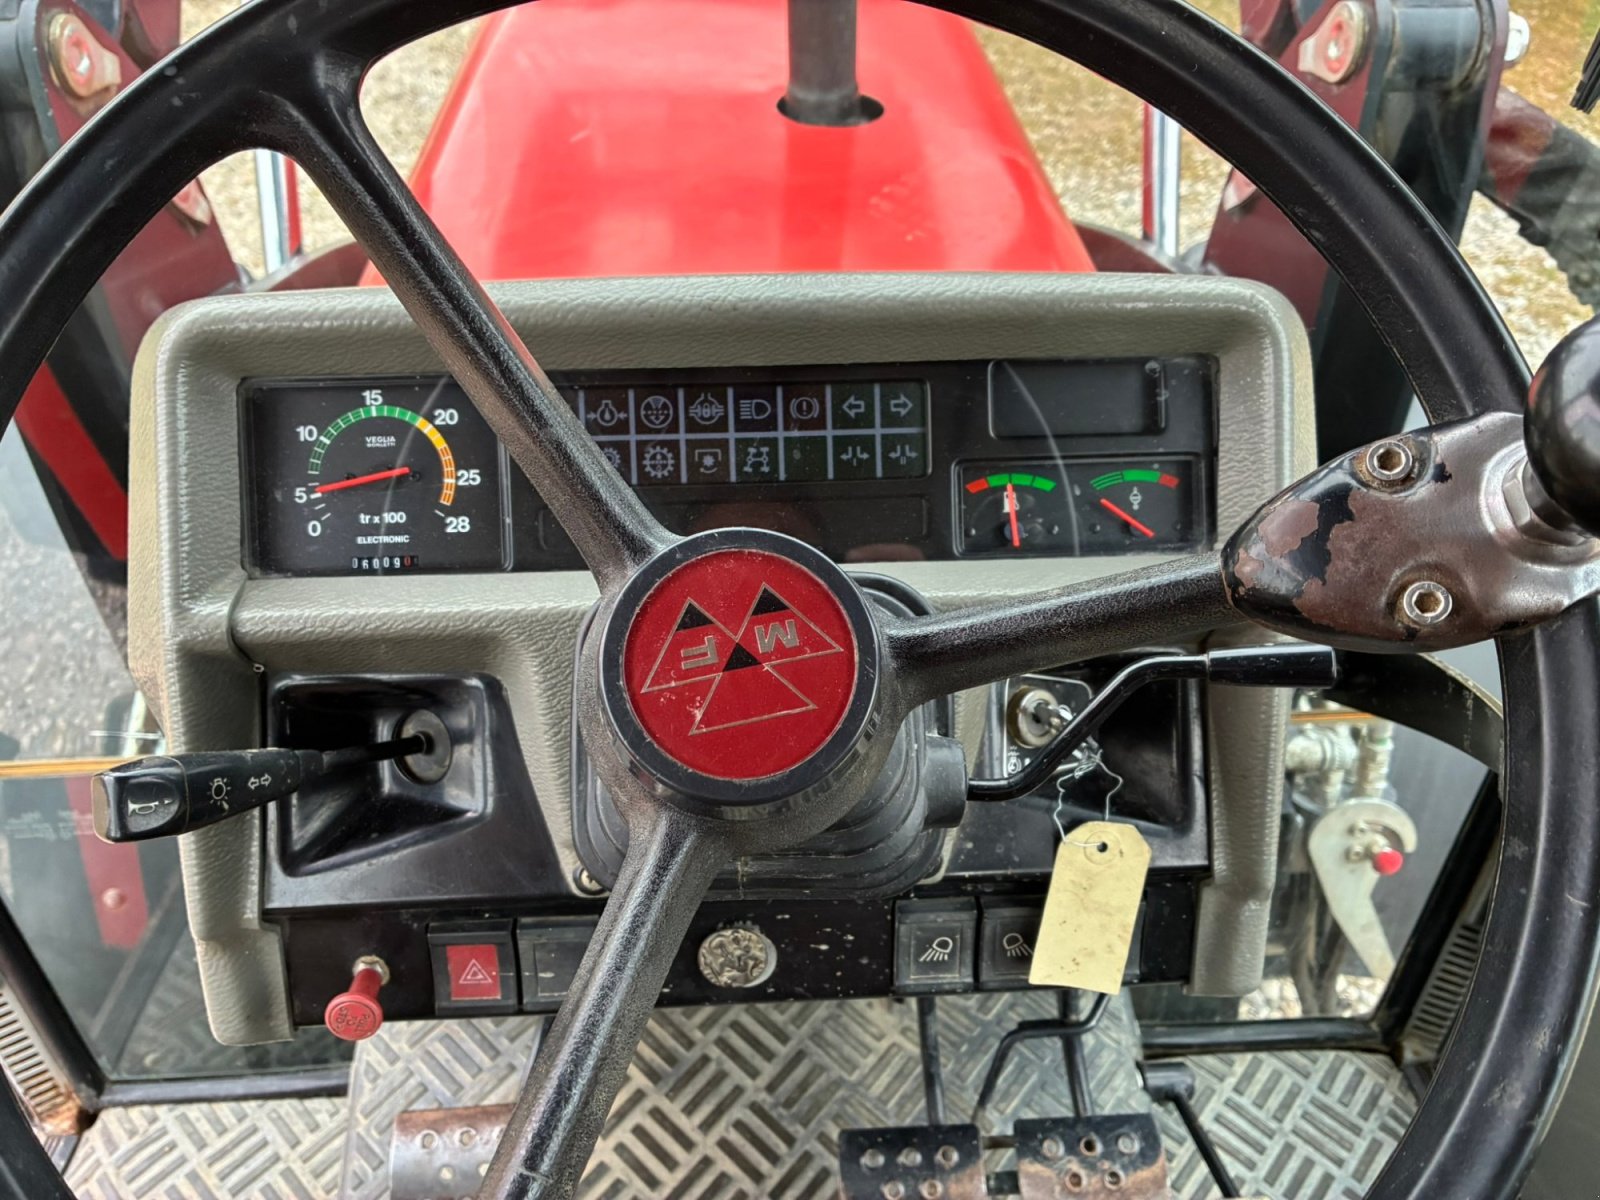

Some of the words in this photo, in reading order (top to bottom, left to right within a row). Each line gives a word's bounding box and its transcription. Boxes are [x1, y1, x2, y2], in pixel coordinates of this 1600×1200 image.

[362, 390, 383, 406] 15
[434, 409, 459, 425] 20
[296, 425, 318, 442] 10
[365, 435, 396, 443] VEGLIA
[457, 470, 481, 486] 25
[294, 488, 308, 503] 5
[359, 513, 371, 524] tr
[373, 515, 380, 524] x
[382, 512, 407, 524] 100
[445, 517, 471, 533] 28
[308, 521, 322, 537] 0
[357, 535, 410, 545] ELECTRONIC
[754, 619, 800, 654] M
[680, 635, 720, 670] F
